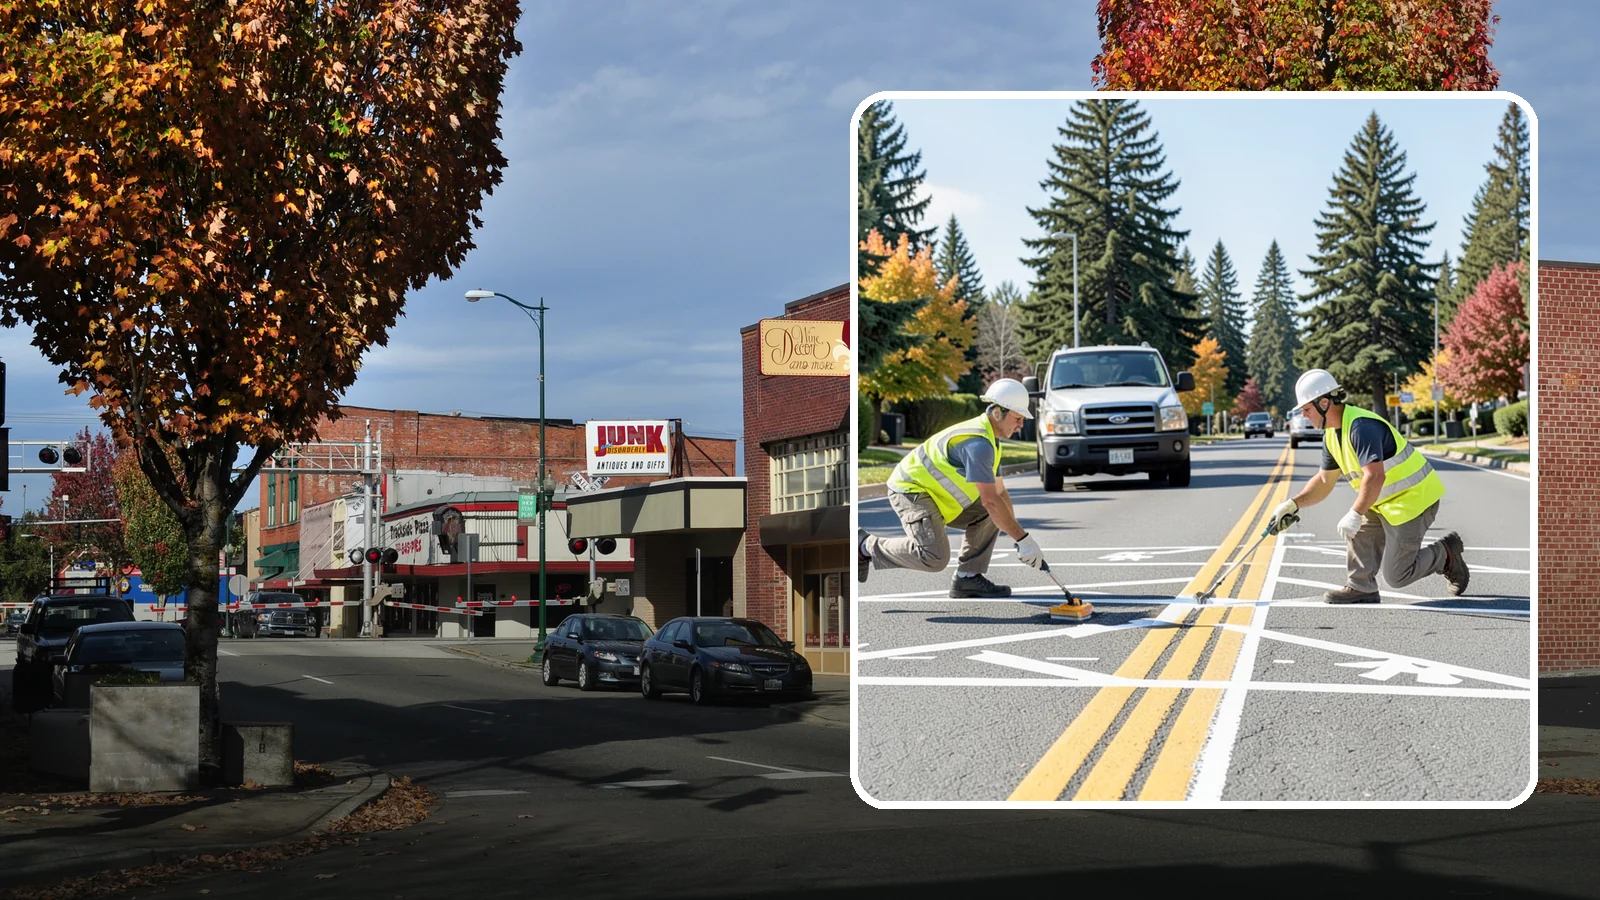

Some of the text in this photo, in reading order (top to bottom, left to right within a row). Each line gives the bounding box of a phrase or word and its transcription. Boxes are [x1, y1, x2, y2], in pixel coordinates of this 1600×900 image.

[595, 425, 665, 457] JUNK
[608, 446, 646, 454] DISORDERLY
[597, 460, 665, 470] ANTIQUES AND GIFTS
